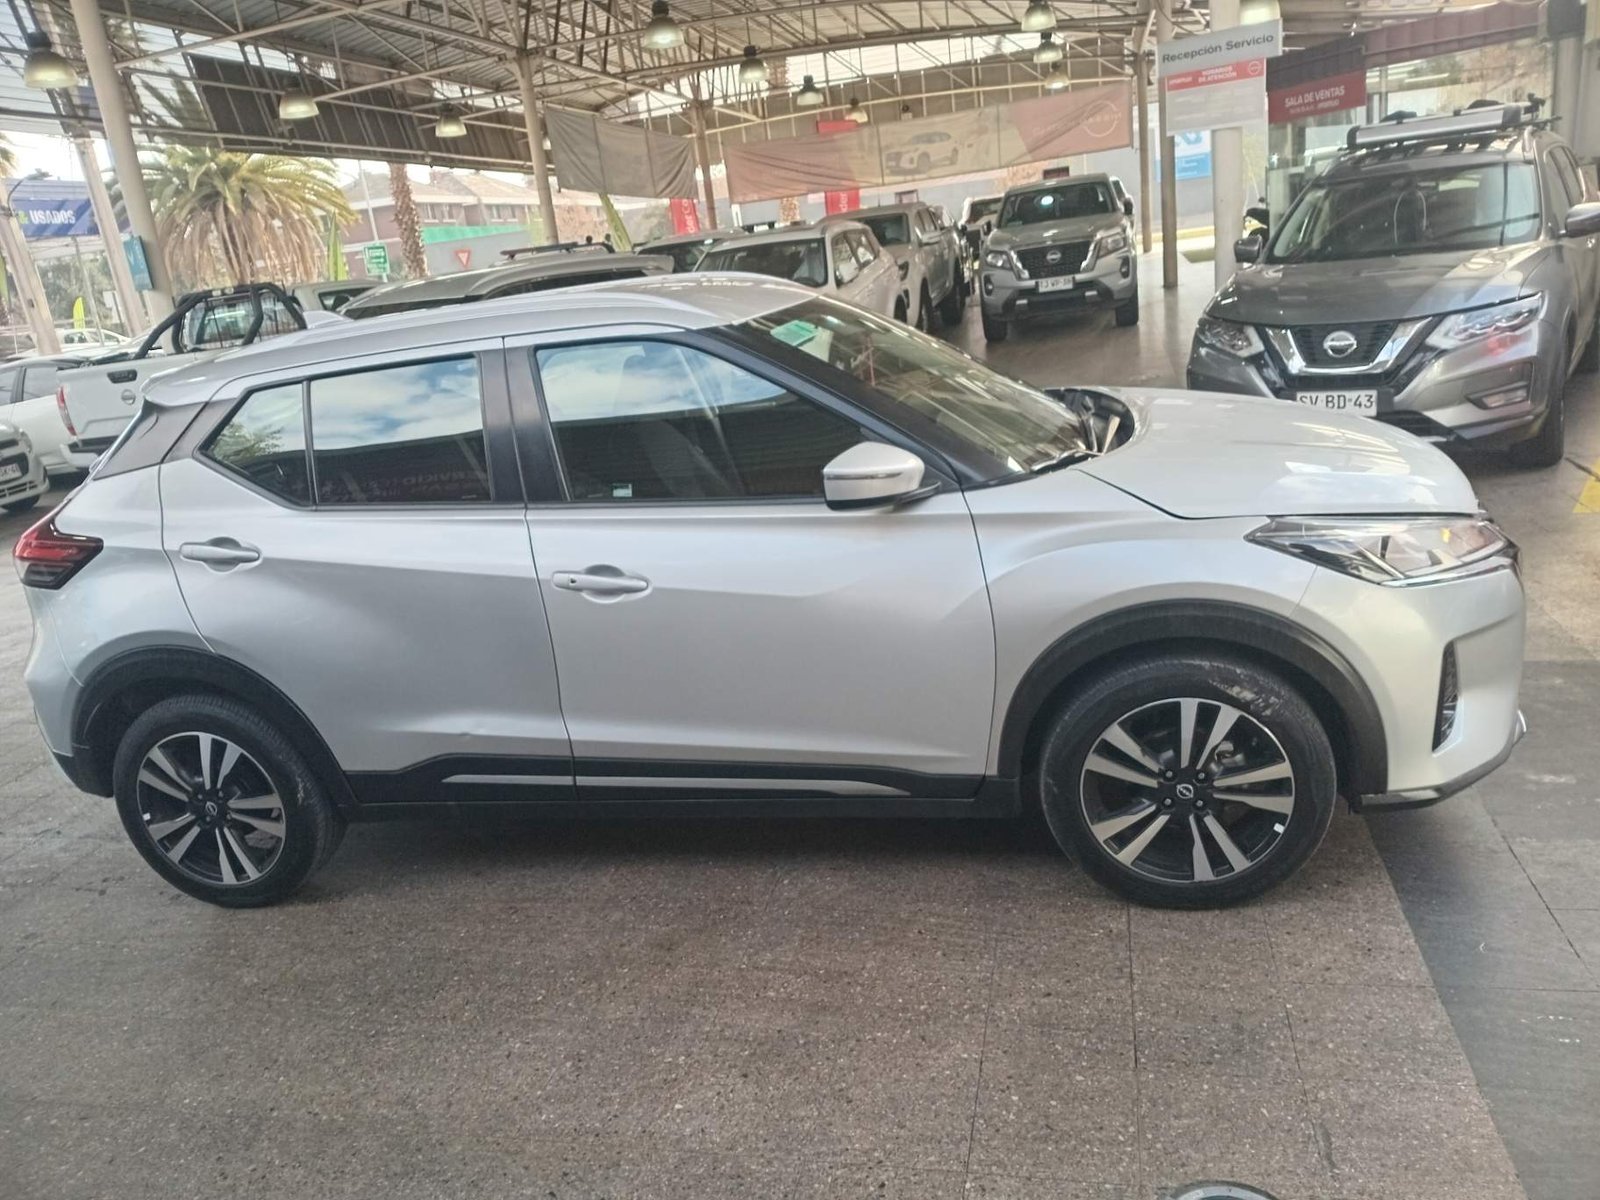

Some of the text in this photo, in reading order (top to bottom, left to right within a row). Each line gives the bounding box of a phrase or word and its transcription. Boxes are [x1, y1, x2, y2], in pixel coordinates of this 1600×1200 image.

[1161, 34, 1274, 63] Recepción Servicio
[1284, 95, 1303, 108] SALA
[1303, 92, 1315, 104] DE
[1314, 85, 1345, 100] VENTAS
[29, 210, 76, 225] USADOS
